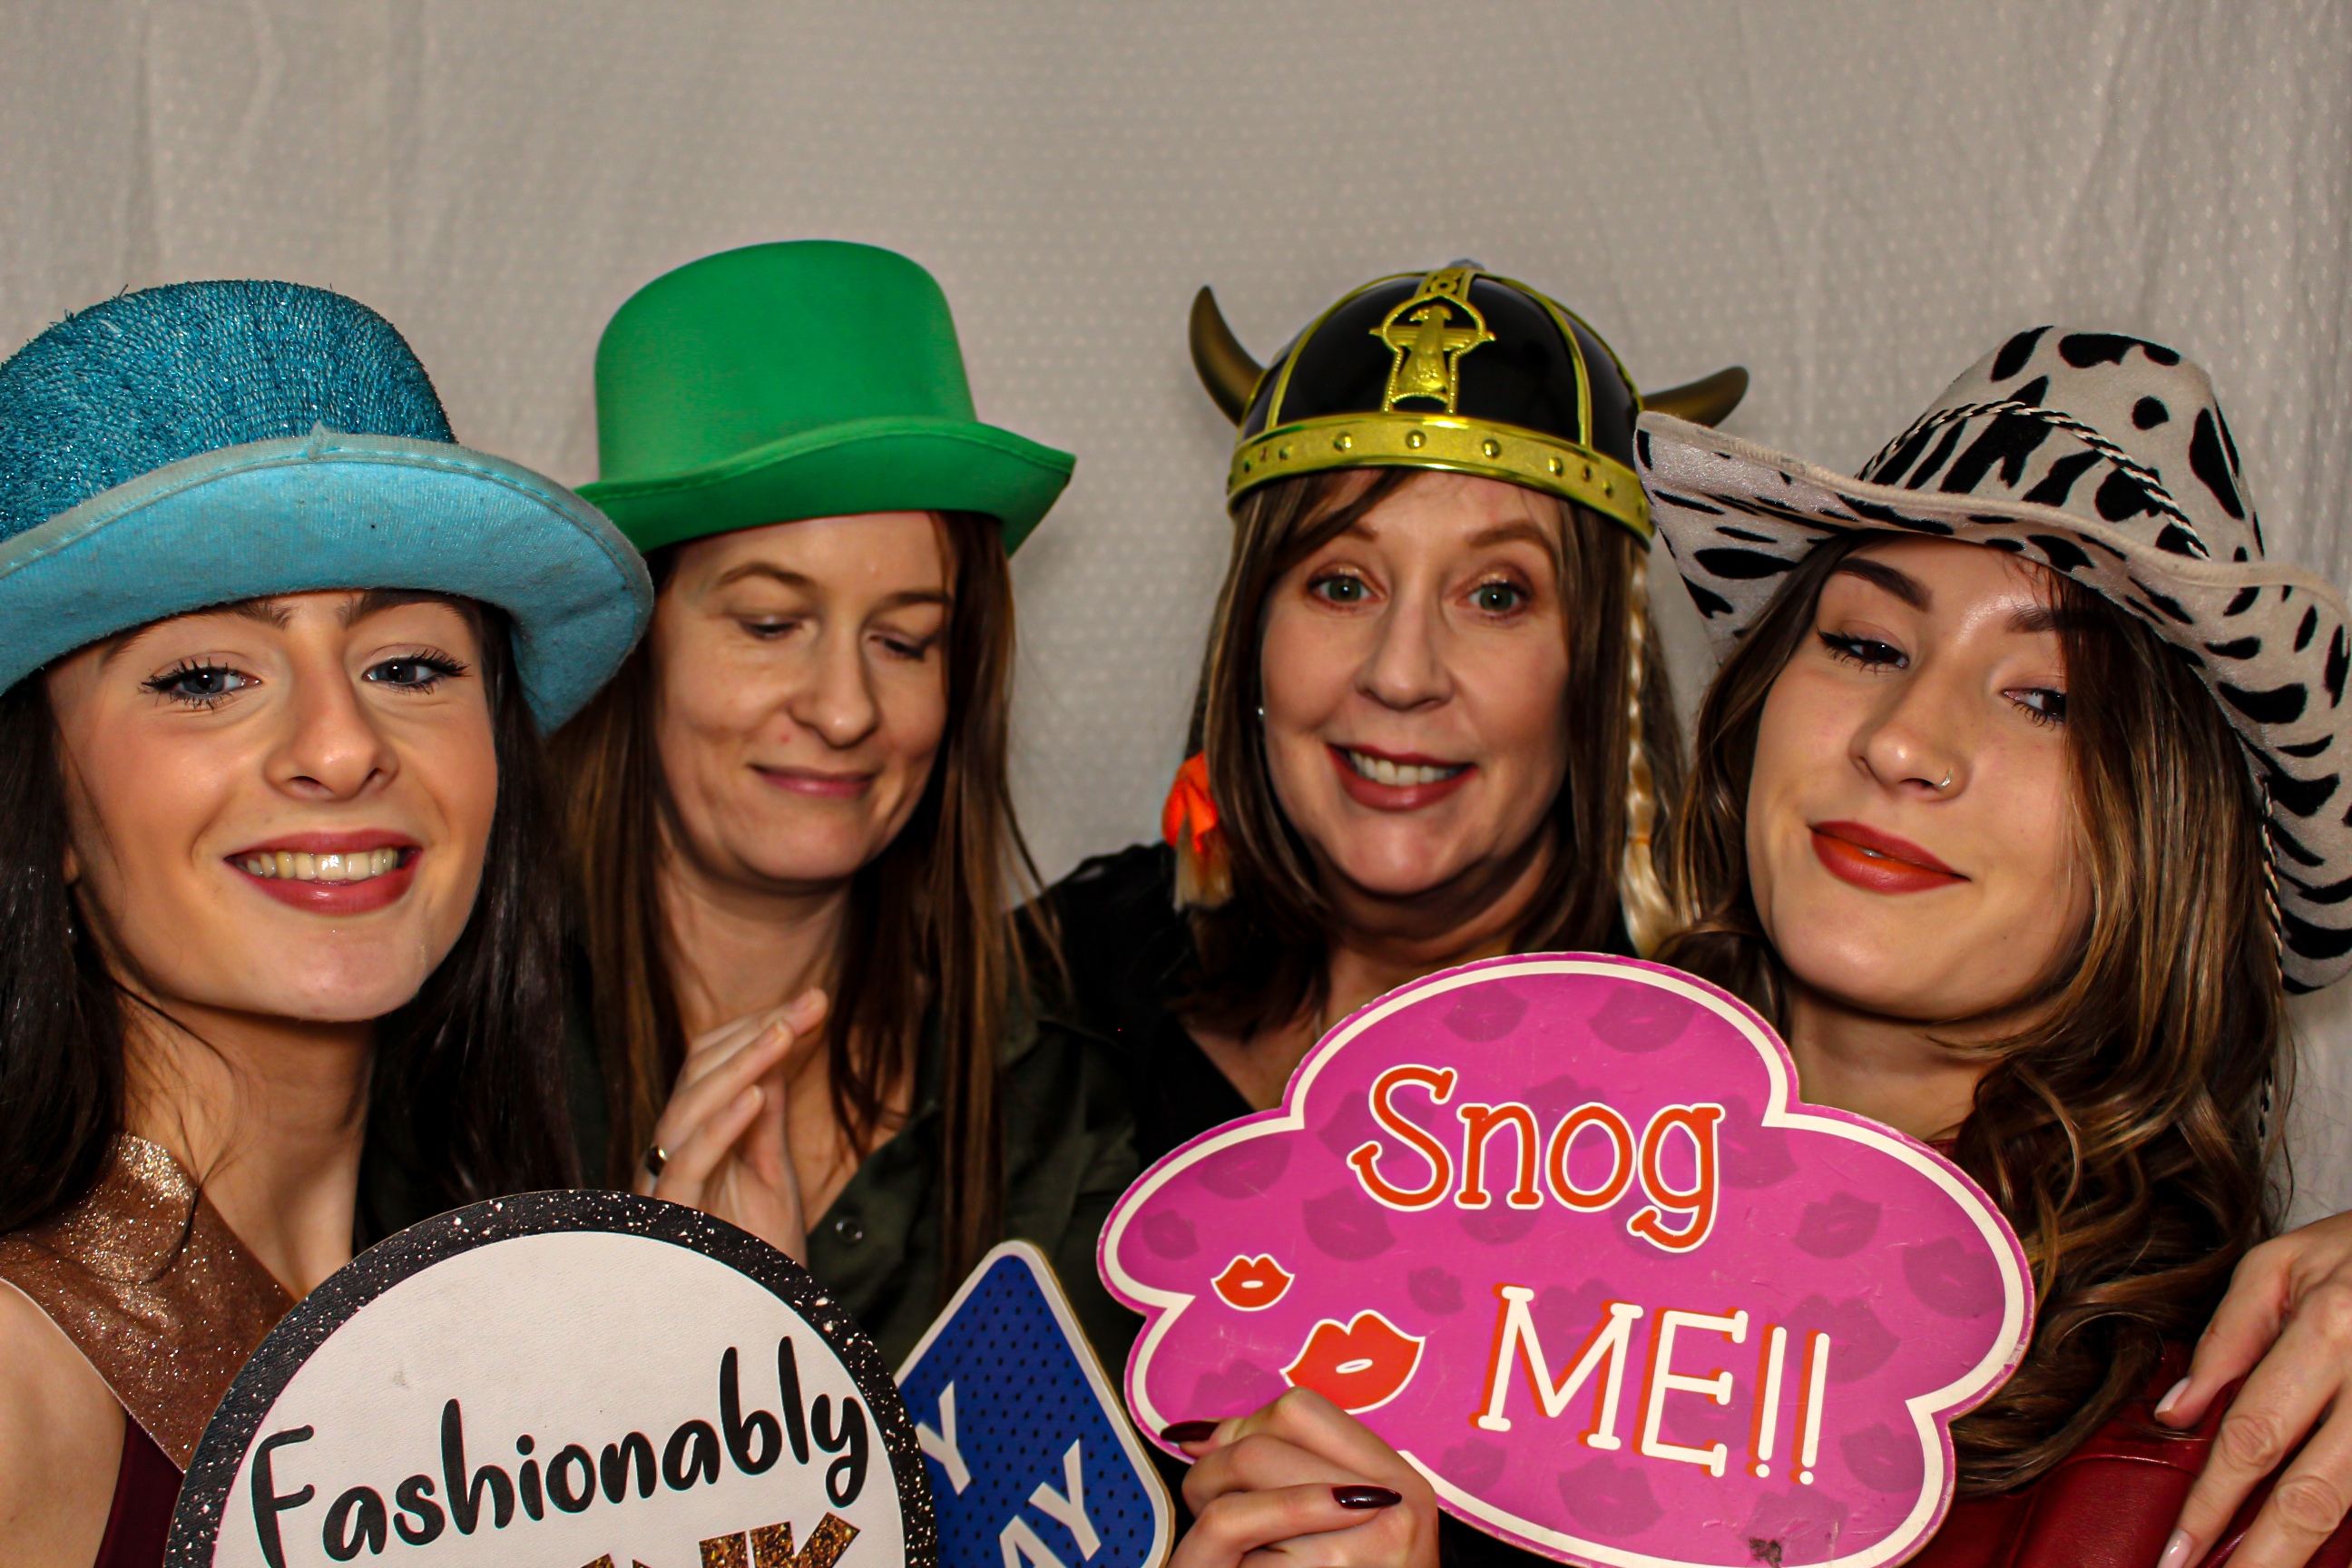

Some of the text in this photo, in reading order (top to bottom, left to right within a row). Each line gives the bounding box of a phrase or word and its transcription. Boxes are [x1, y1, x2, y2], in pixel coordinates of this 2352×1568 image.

[1348, 1064, 1726, 1254] Snog
[250, 1335, 869, 1568] Fashionably
[915, 1379, 972, 1496] Y
[1469, 1283, 1830, 1485] ME!!
[998, 1437, 1102, 1568] AY
